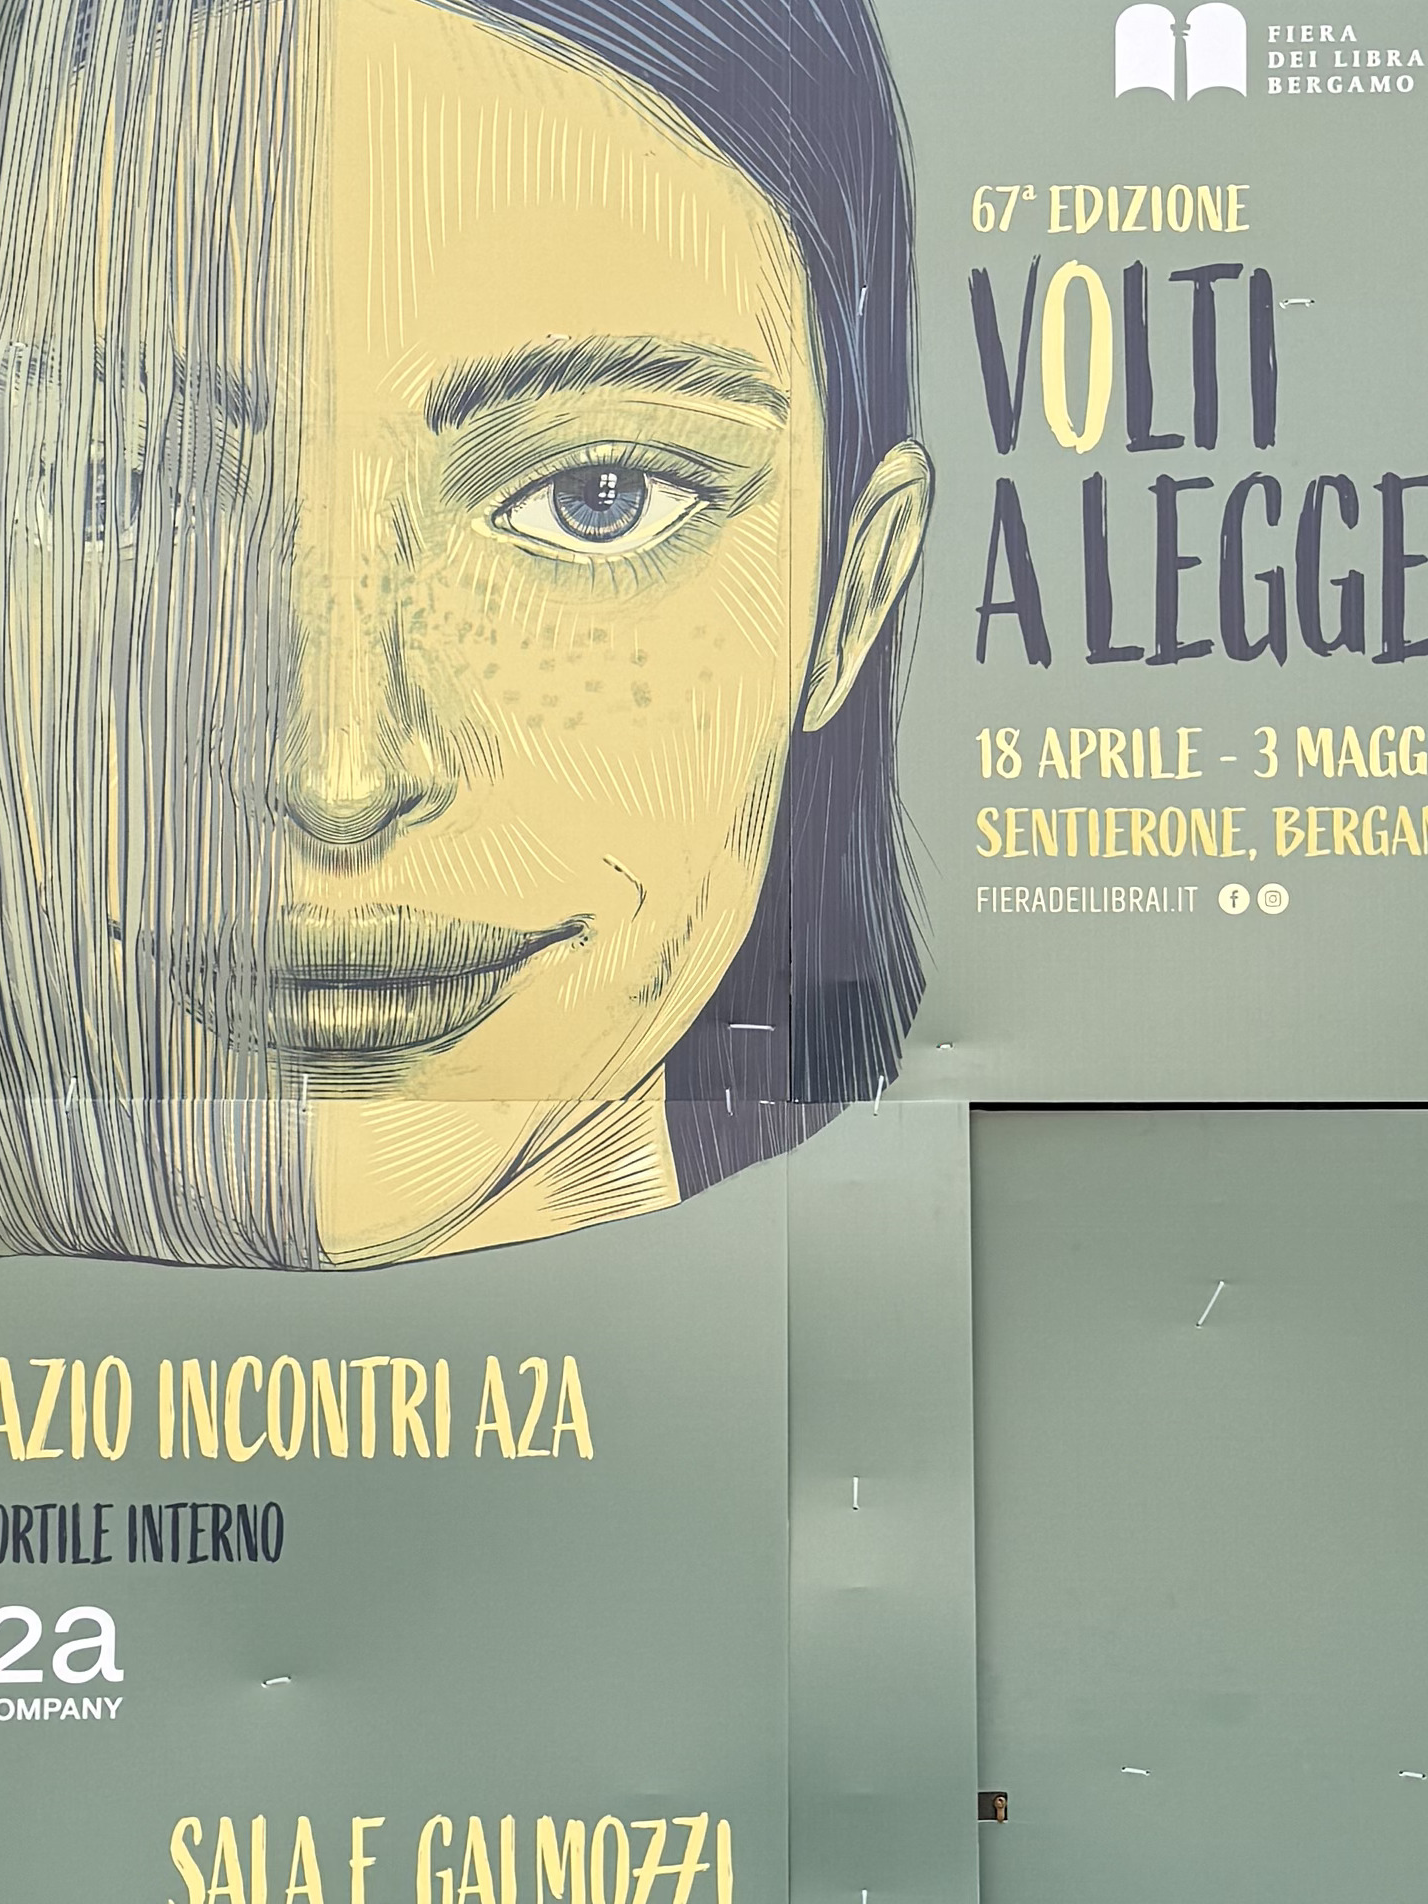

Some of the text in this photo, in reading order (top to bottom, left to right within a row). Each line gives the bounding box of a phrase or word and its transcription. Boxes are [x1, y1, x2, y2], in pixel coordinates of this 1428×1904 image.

[1268, 25, 1358, 43] FIERA
[1268, 50, 1318, 68] DEI
[1268, 74, 1415, 95] BERGAMO
[1047, 184, 1251, 234] EDIZIONE
[969, 254, 1278, 455] VOLTI
[976, 477, 1052, 669] A
[976, 727, 1022, 779] 18
[1038, 726, 1204, 780] APRILE
[1253, 726, 1279, 778] 3
[976, 805, 1257, 861] SENTIERONE,
[977, 886, 1199, 913] FIERADEILIBRAI.IT
[158, 1355, 450, 1462] INCONTRI
[475, 1355, 594, 1460] A2A
[127, 1501, 284, 1565] INTERNO
